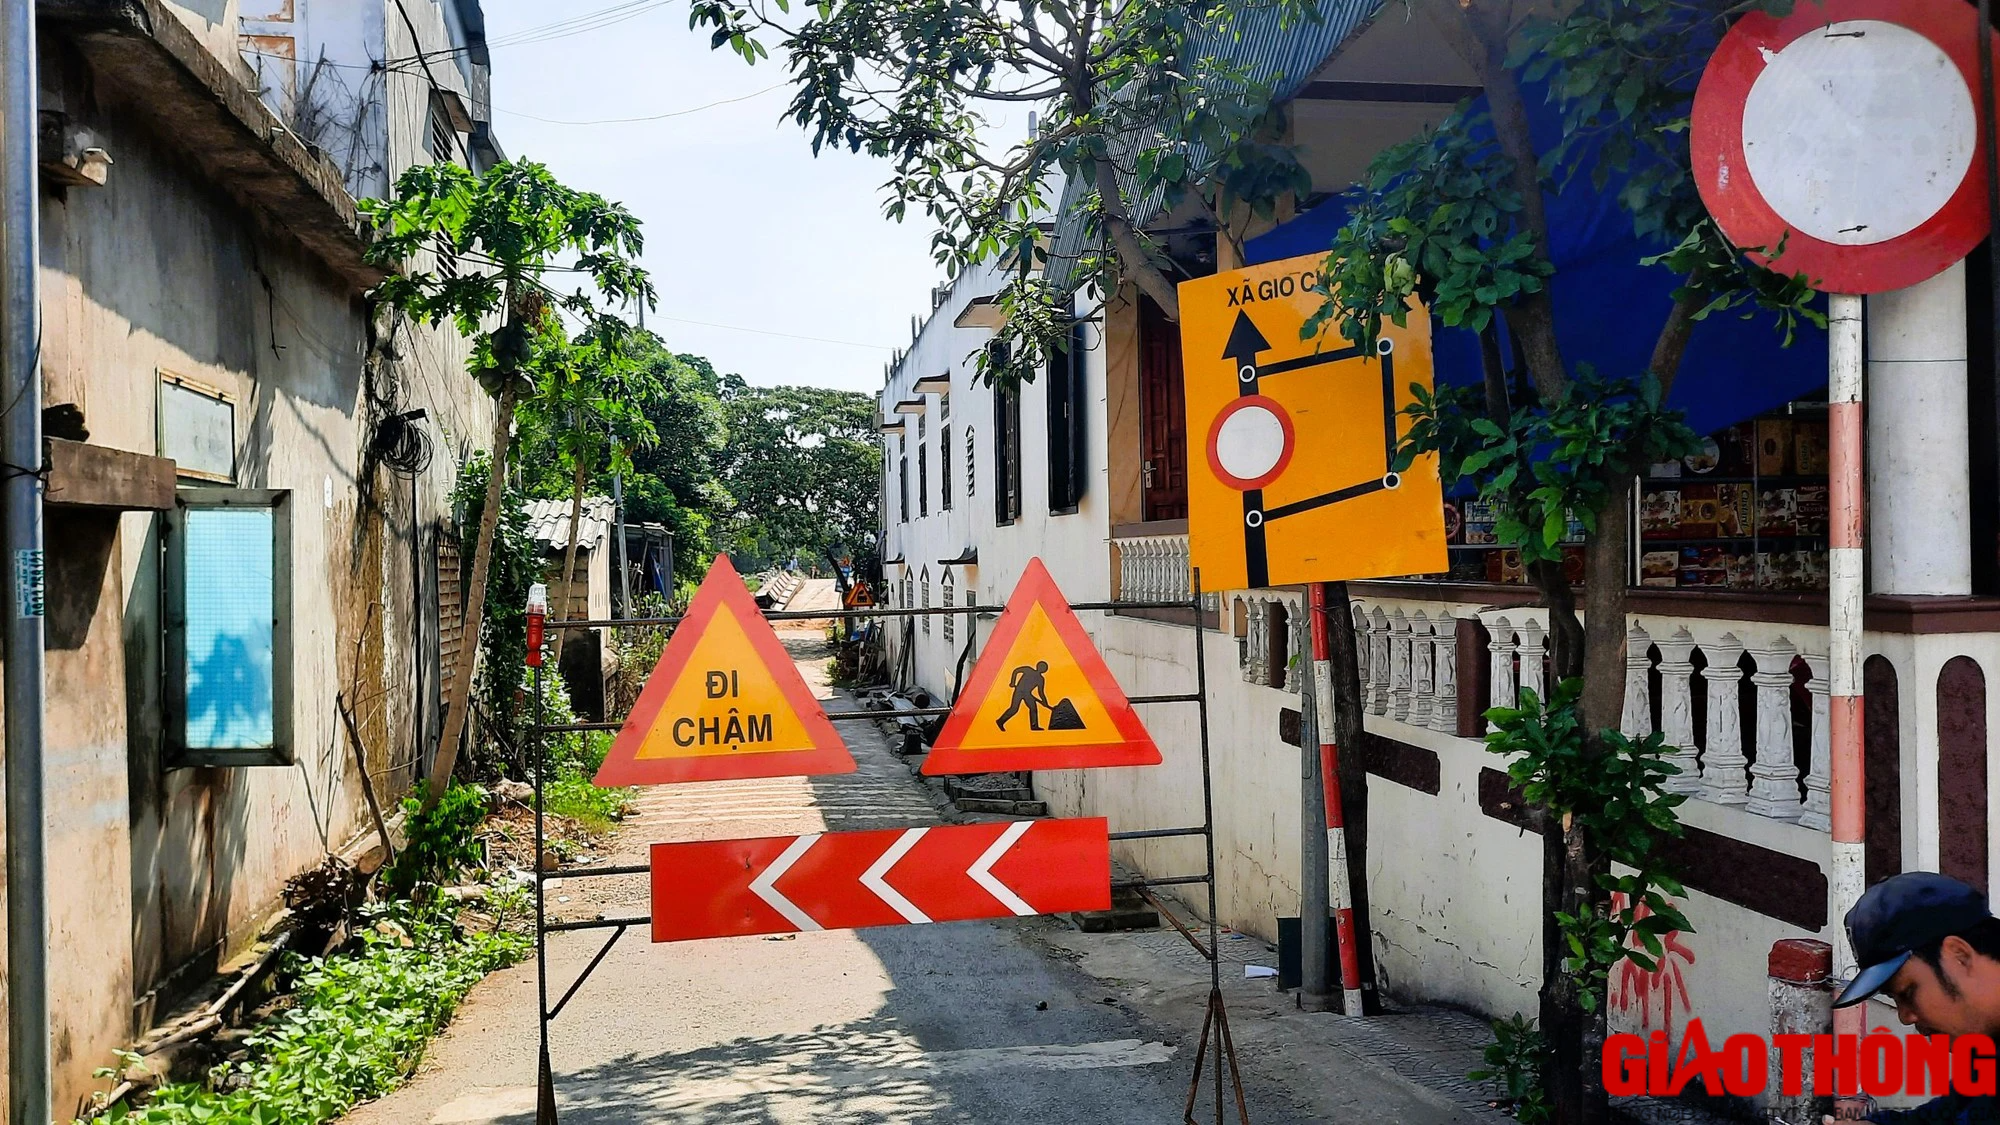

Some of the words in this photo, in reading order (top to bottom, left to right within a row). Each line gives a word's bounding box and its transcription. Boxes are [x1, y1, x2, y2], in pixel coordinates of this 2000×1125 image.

[1226, 278, 1255, 307] XÃ
[1258, 276, 1295, 302] GIO
[705, 670, 739, 699] ĐI
[672, 707, 773, 751] CHẬM
